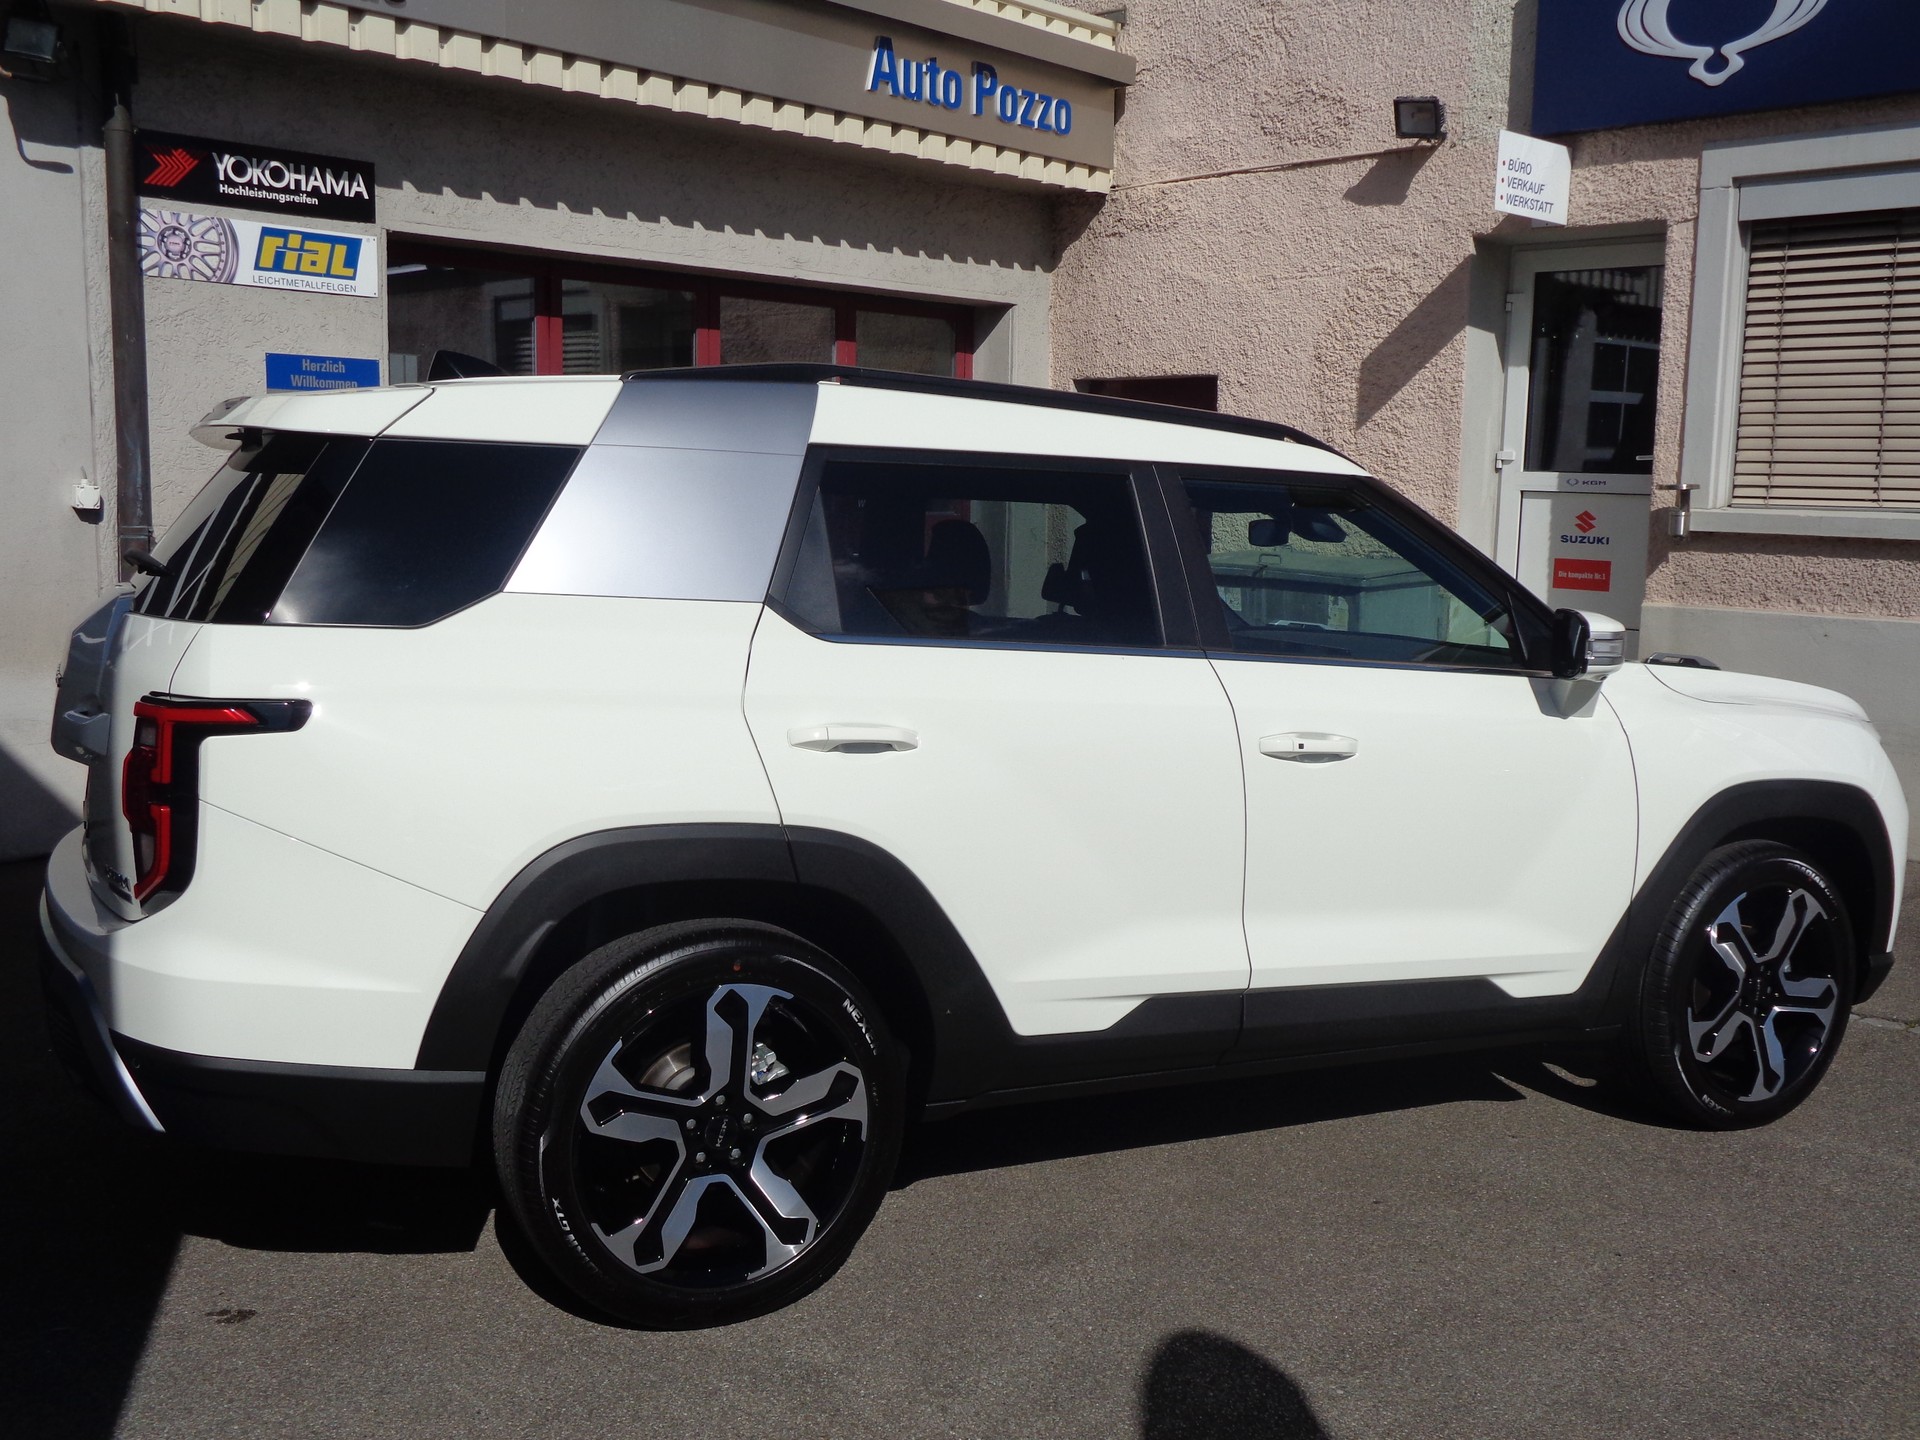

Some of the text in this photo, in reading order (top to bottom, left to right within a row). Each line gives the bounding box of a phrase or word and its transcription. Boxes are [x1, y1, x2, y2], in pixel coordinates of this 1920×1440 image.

[865, 35, 1072, 136] Auto Pozzo
[212, 152, 369, 199] YOKOHAMA
[1508, 158, 1532, 175] BÜRO
[219, 184, 318, 205] Hochleistungsreifen
[1507, 176, 1545, 195] VERKAUF
[1506, 193, 1554, 214] WERKSTATT
[252, 275, 357, 293] LEICHTMETALLFELGEN
[302, 359, 345, 373] Herzlich
[290, 374, 358, 389] Willkommen
[1560, 534, 1610, 545] SUZUKI
